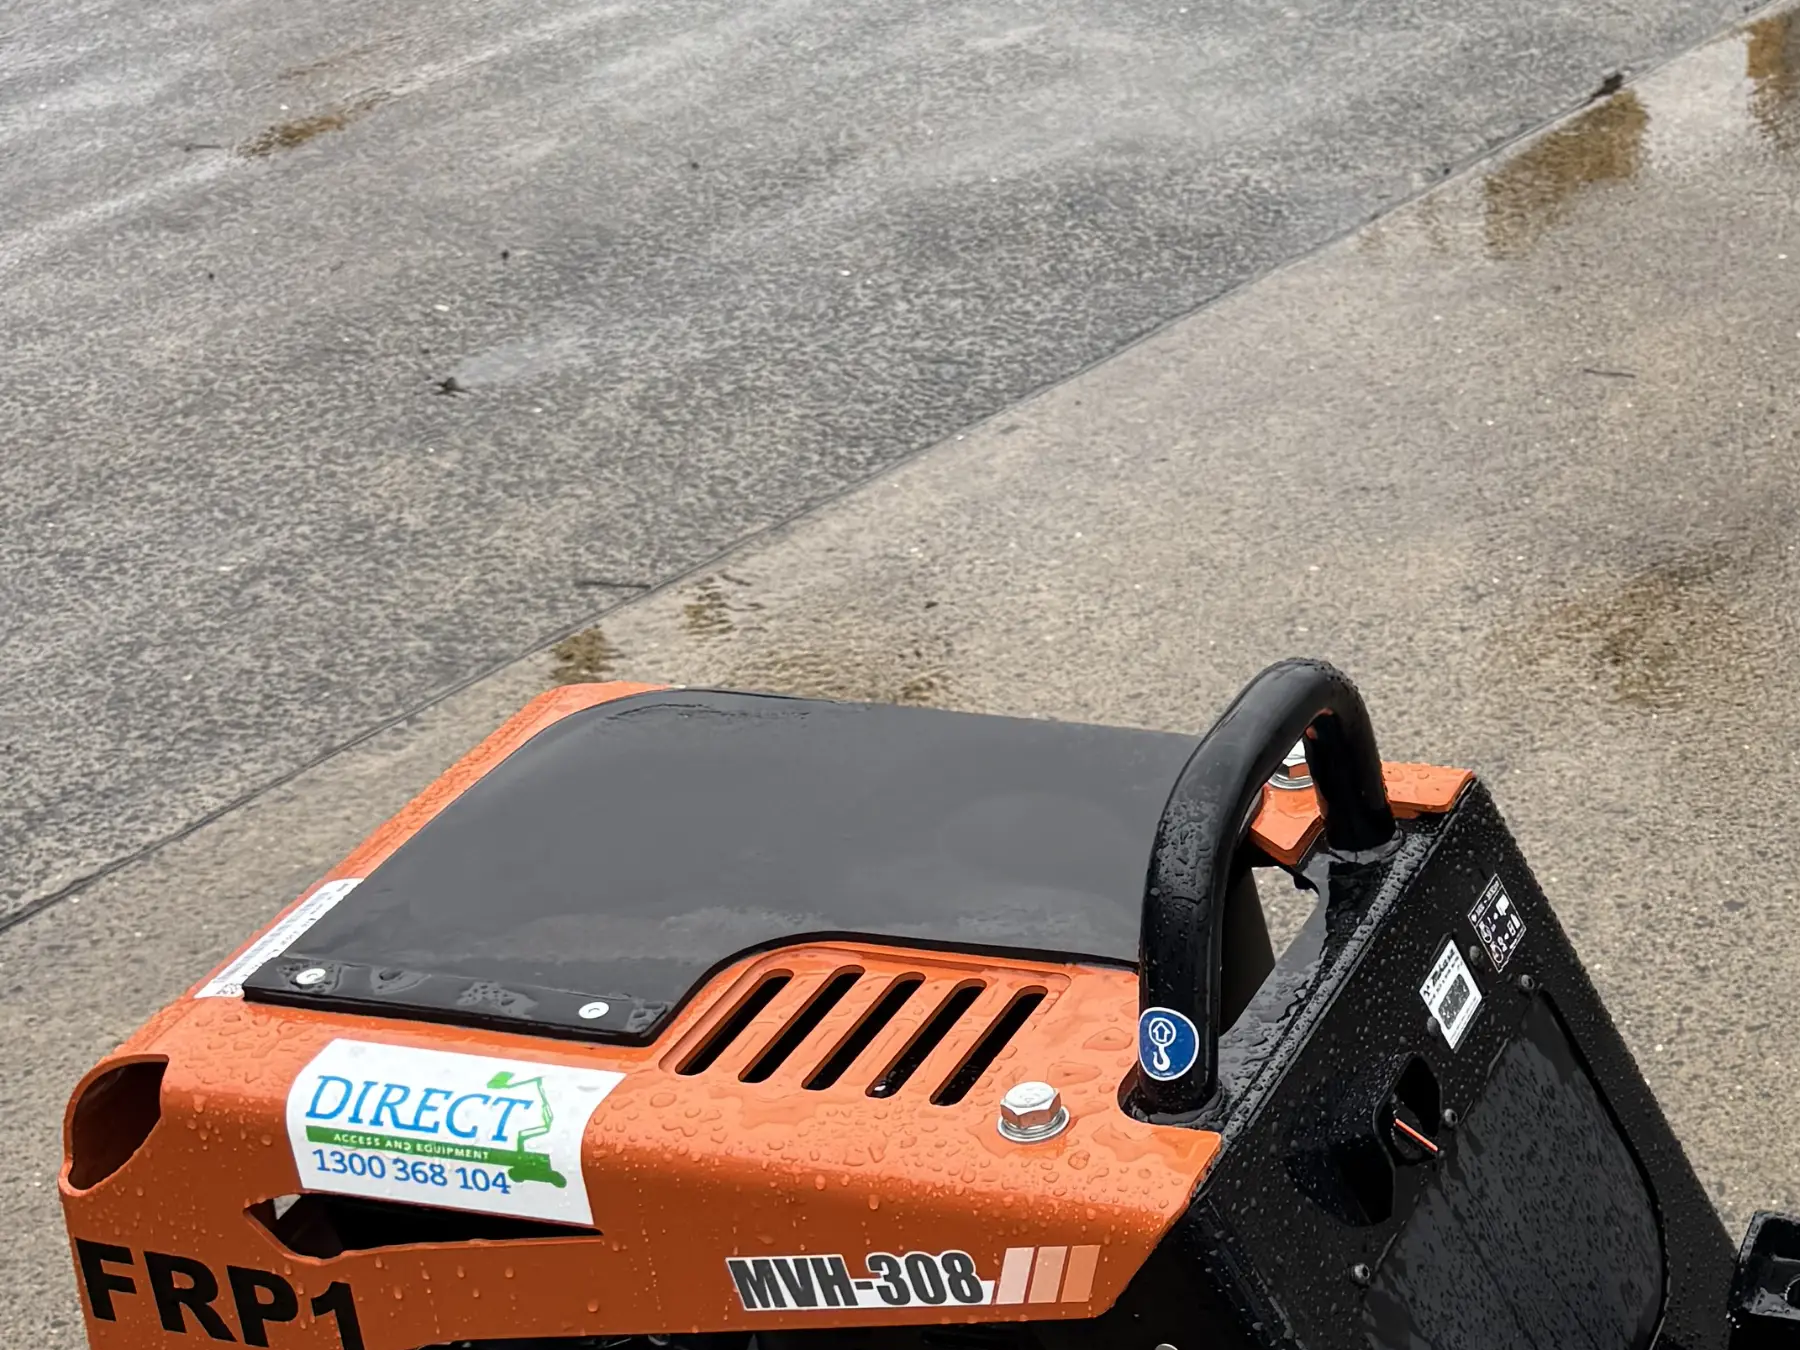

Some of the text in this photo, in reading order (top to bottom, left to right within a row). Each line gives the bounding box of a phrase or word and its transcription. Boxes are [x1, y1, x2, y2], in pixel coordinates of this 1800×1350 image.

[305, 1075, 534, 1142] DIRECT
[312, 1148, 511, 1195] 1300 368 104
[333, 1132, 490, 1161] ACCESS AND EQUIPMENT
[727, 1251, 985, 1310] MVH-308
